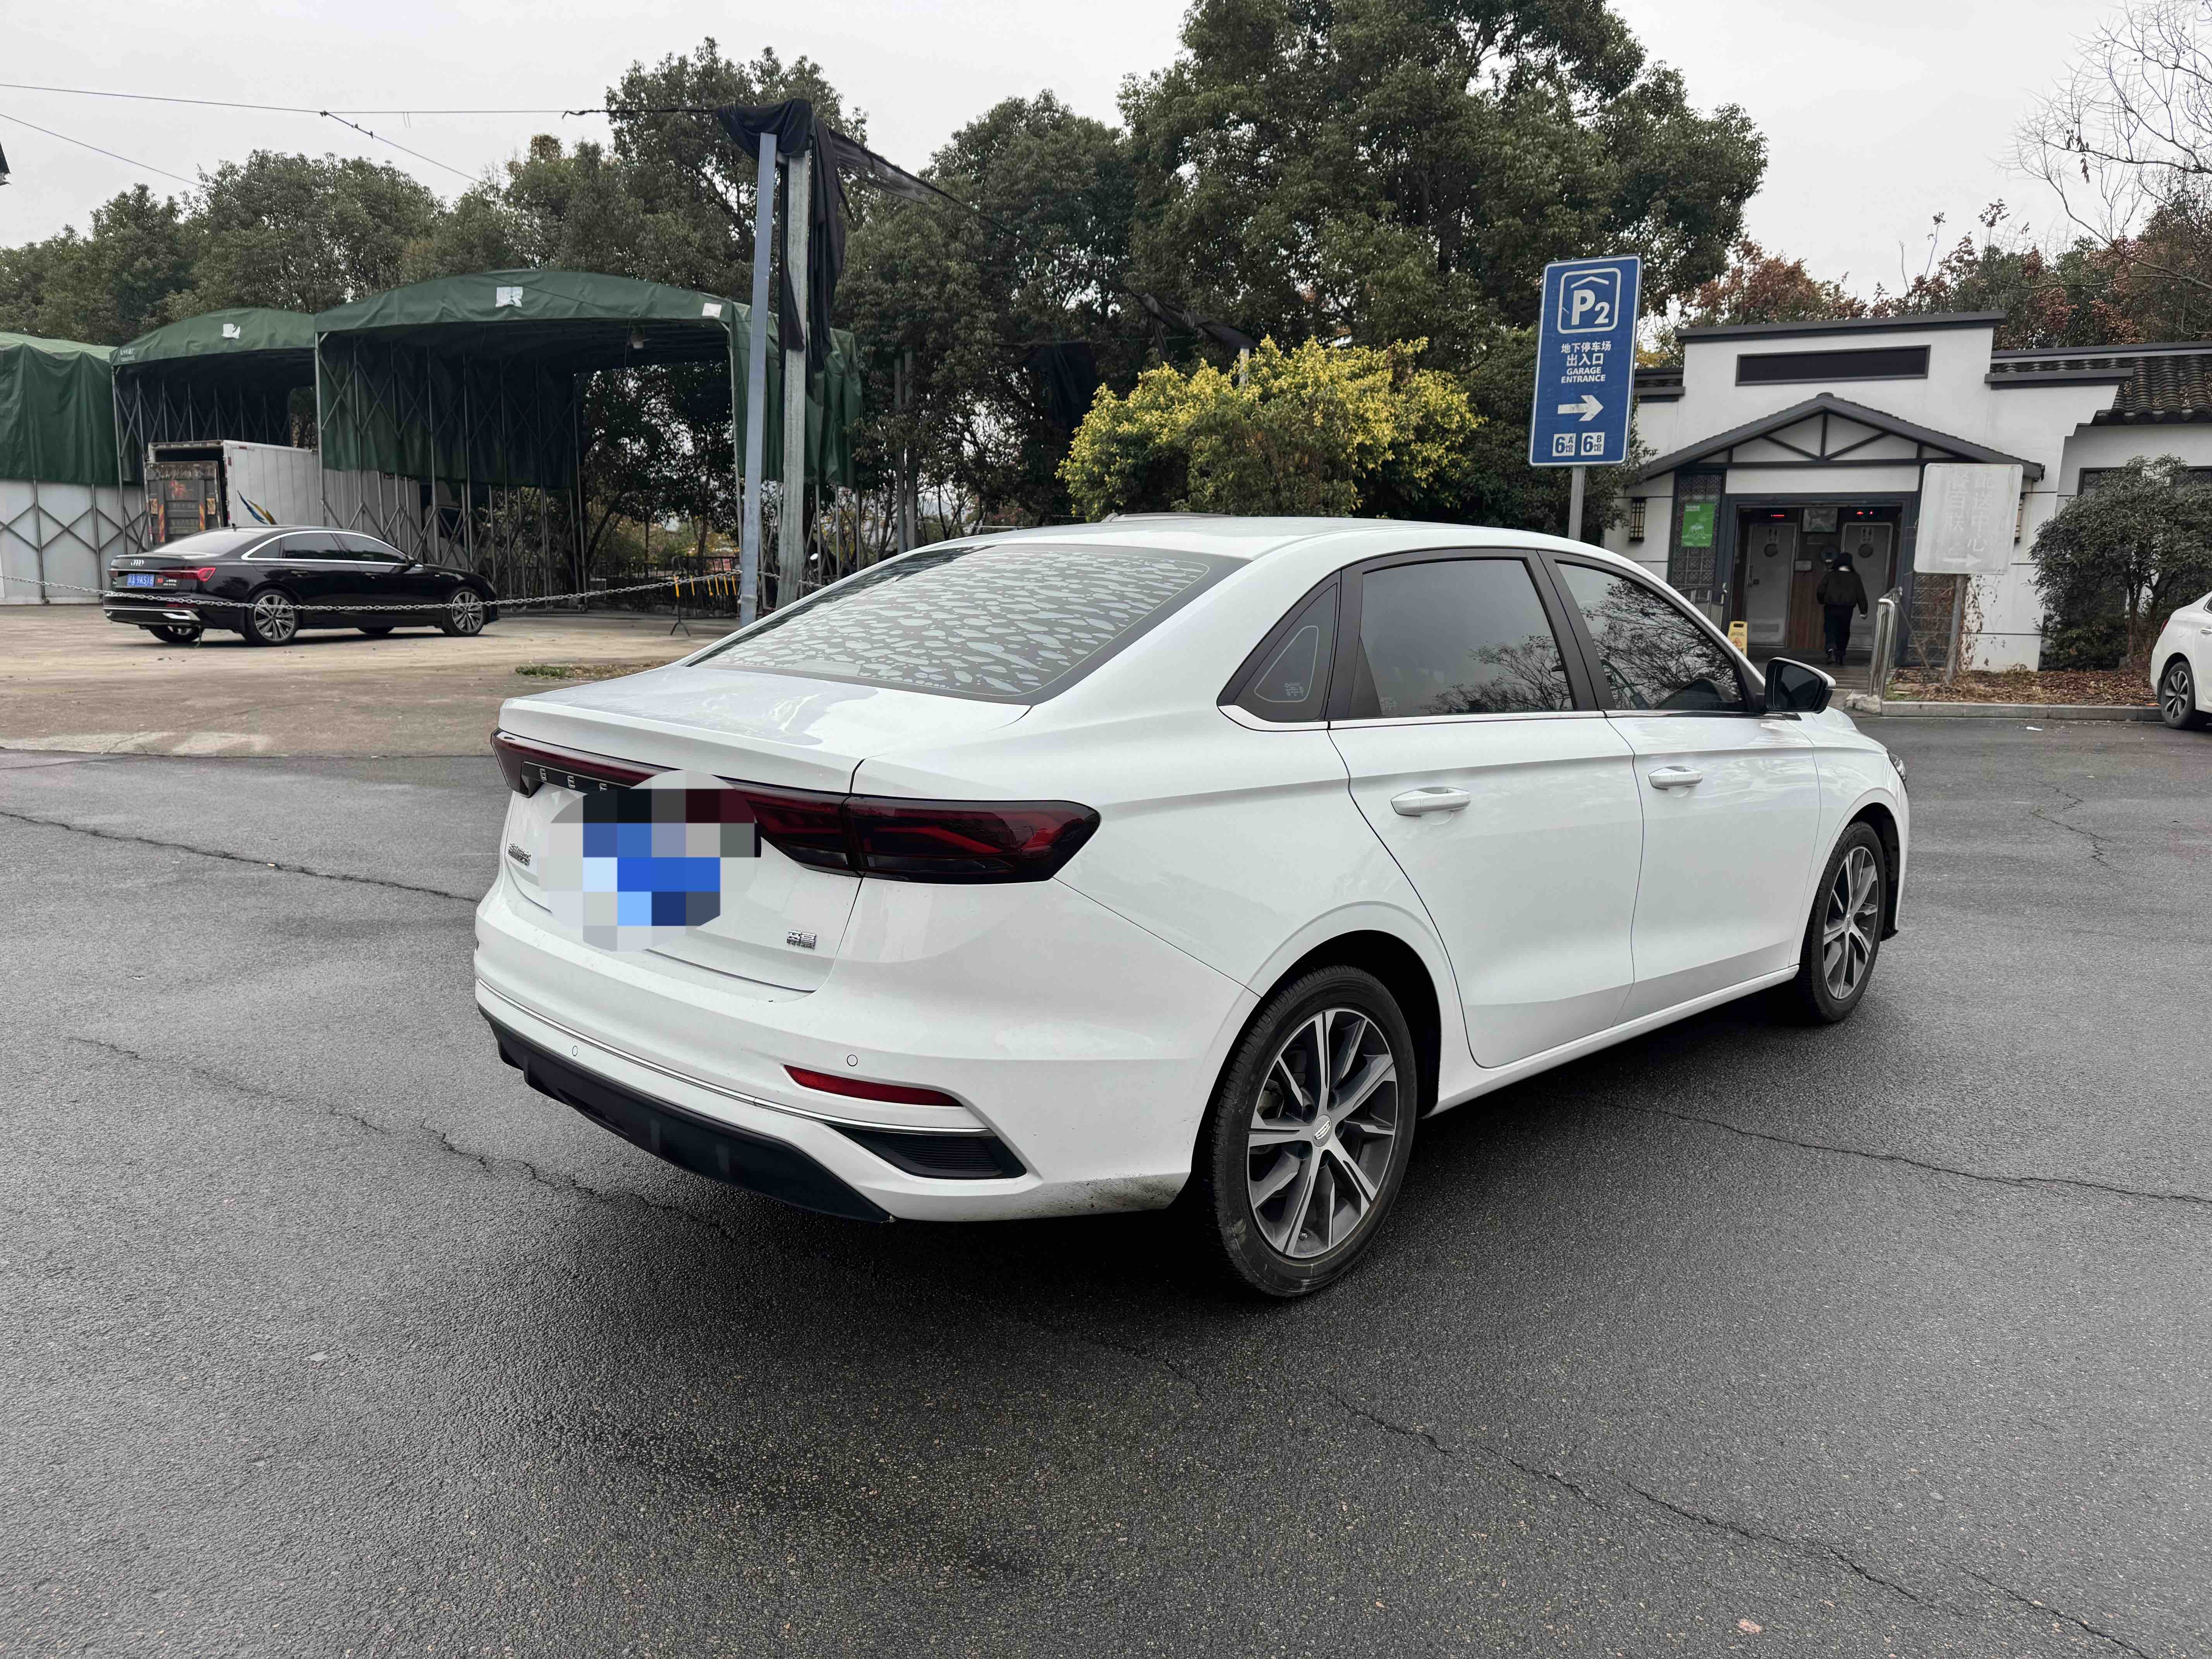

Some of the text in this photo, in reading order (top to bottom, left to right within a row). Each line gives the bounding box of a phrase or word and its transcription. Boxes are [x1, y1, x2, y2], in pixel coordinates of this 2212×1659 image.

[1571, 289, 1610, 325] P2
[1561, 340, 1611, 354] 地下停车场
[1566, 353, 1604, 367] 出入口
[1566, 366, 1602, 375] GARAGE
[1561, 374, 1606, 383] ENTRANCE
